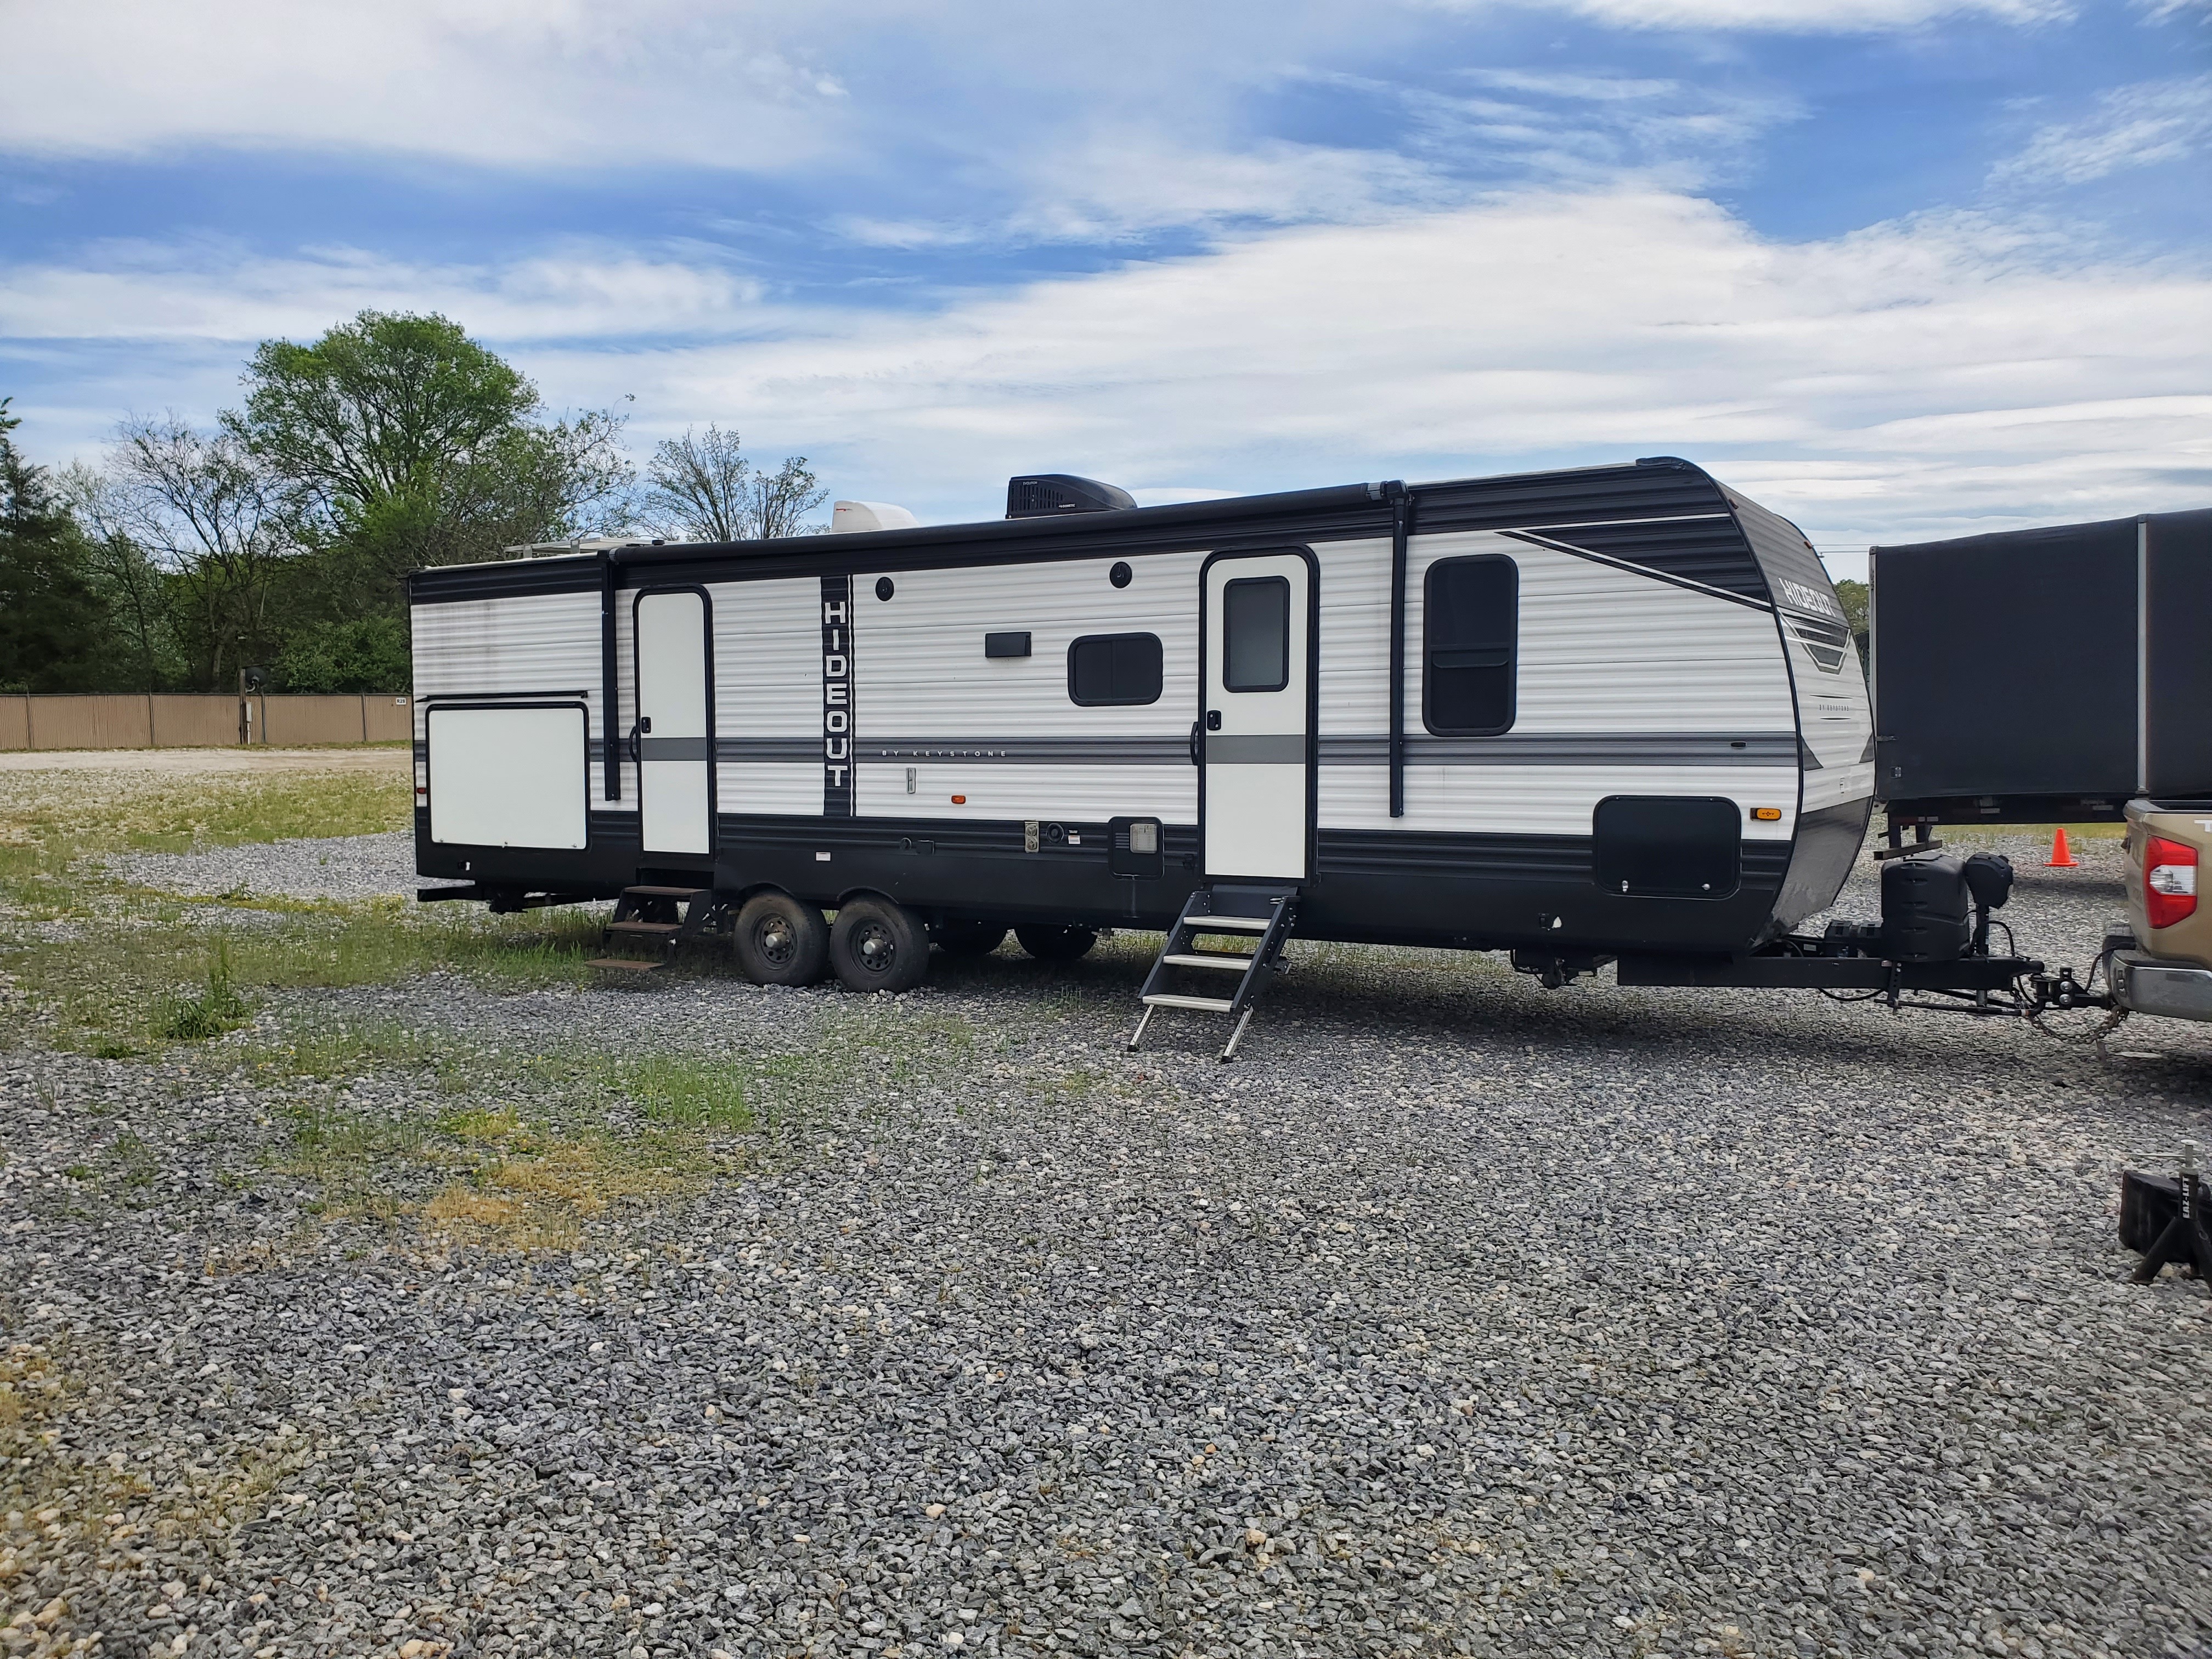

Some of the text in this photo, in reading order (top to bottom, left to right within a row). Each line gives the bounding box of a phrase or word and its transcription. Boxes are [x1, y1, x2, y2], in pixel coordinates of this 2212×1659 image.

[1778, 577, 1836, 618] HIDEOUT
[825, 601, 848, 787] HIDEOUT
[2182, 1176, 2190, 1218] EAZ-LIFT
